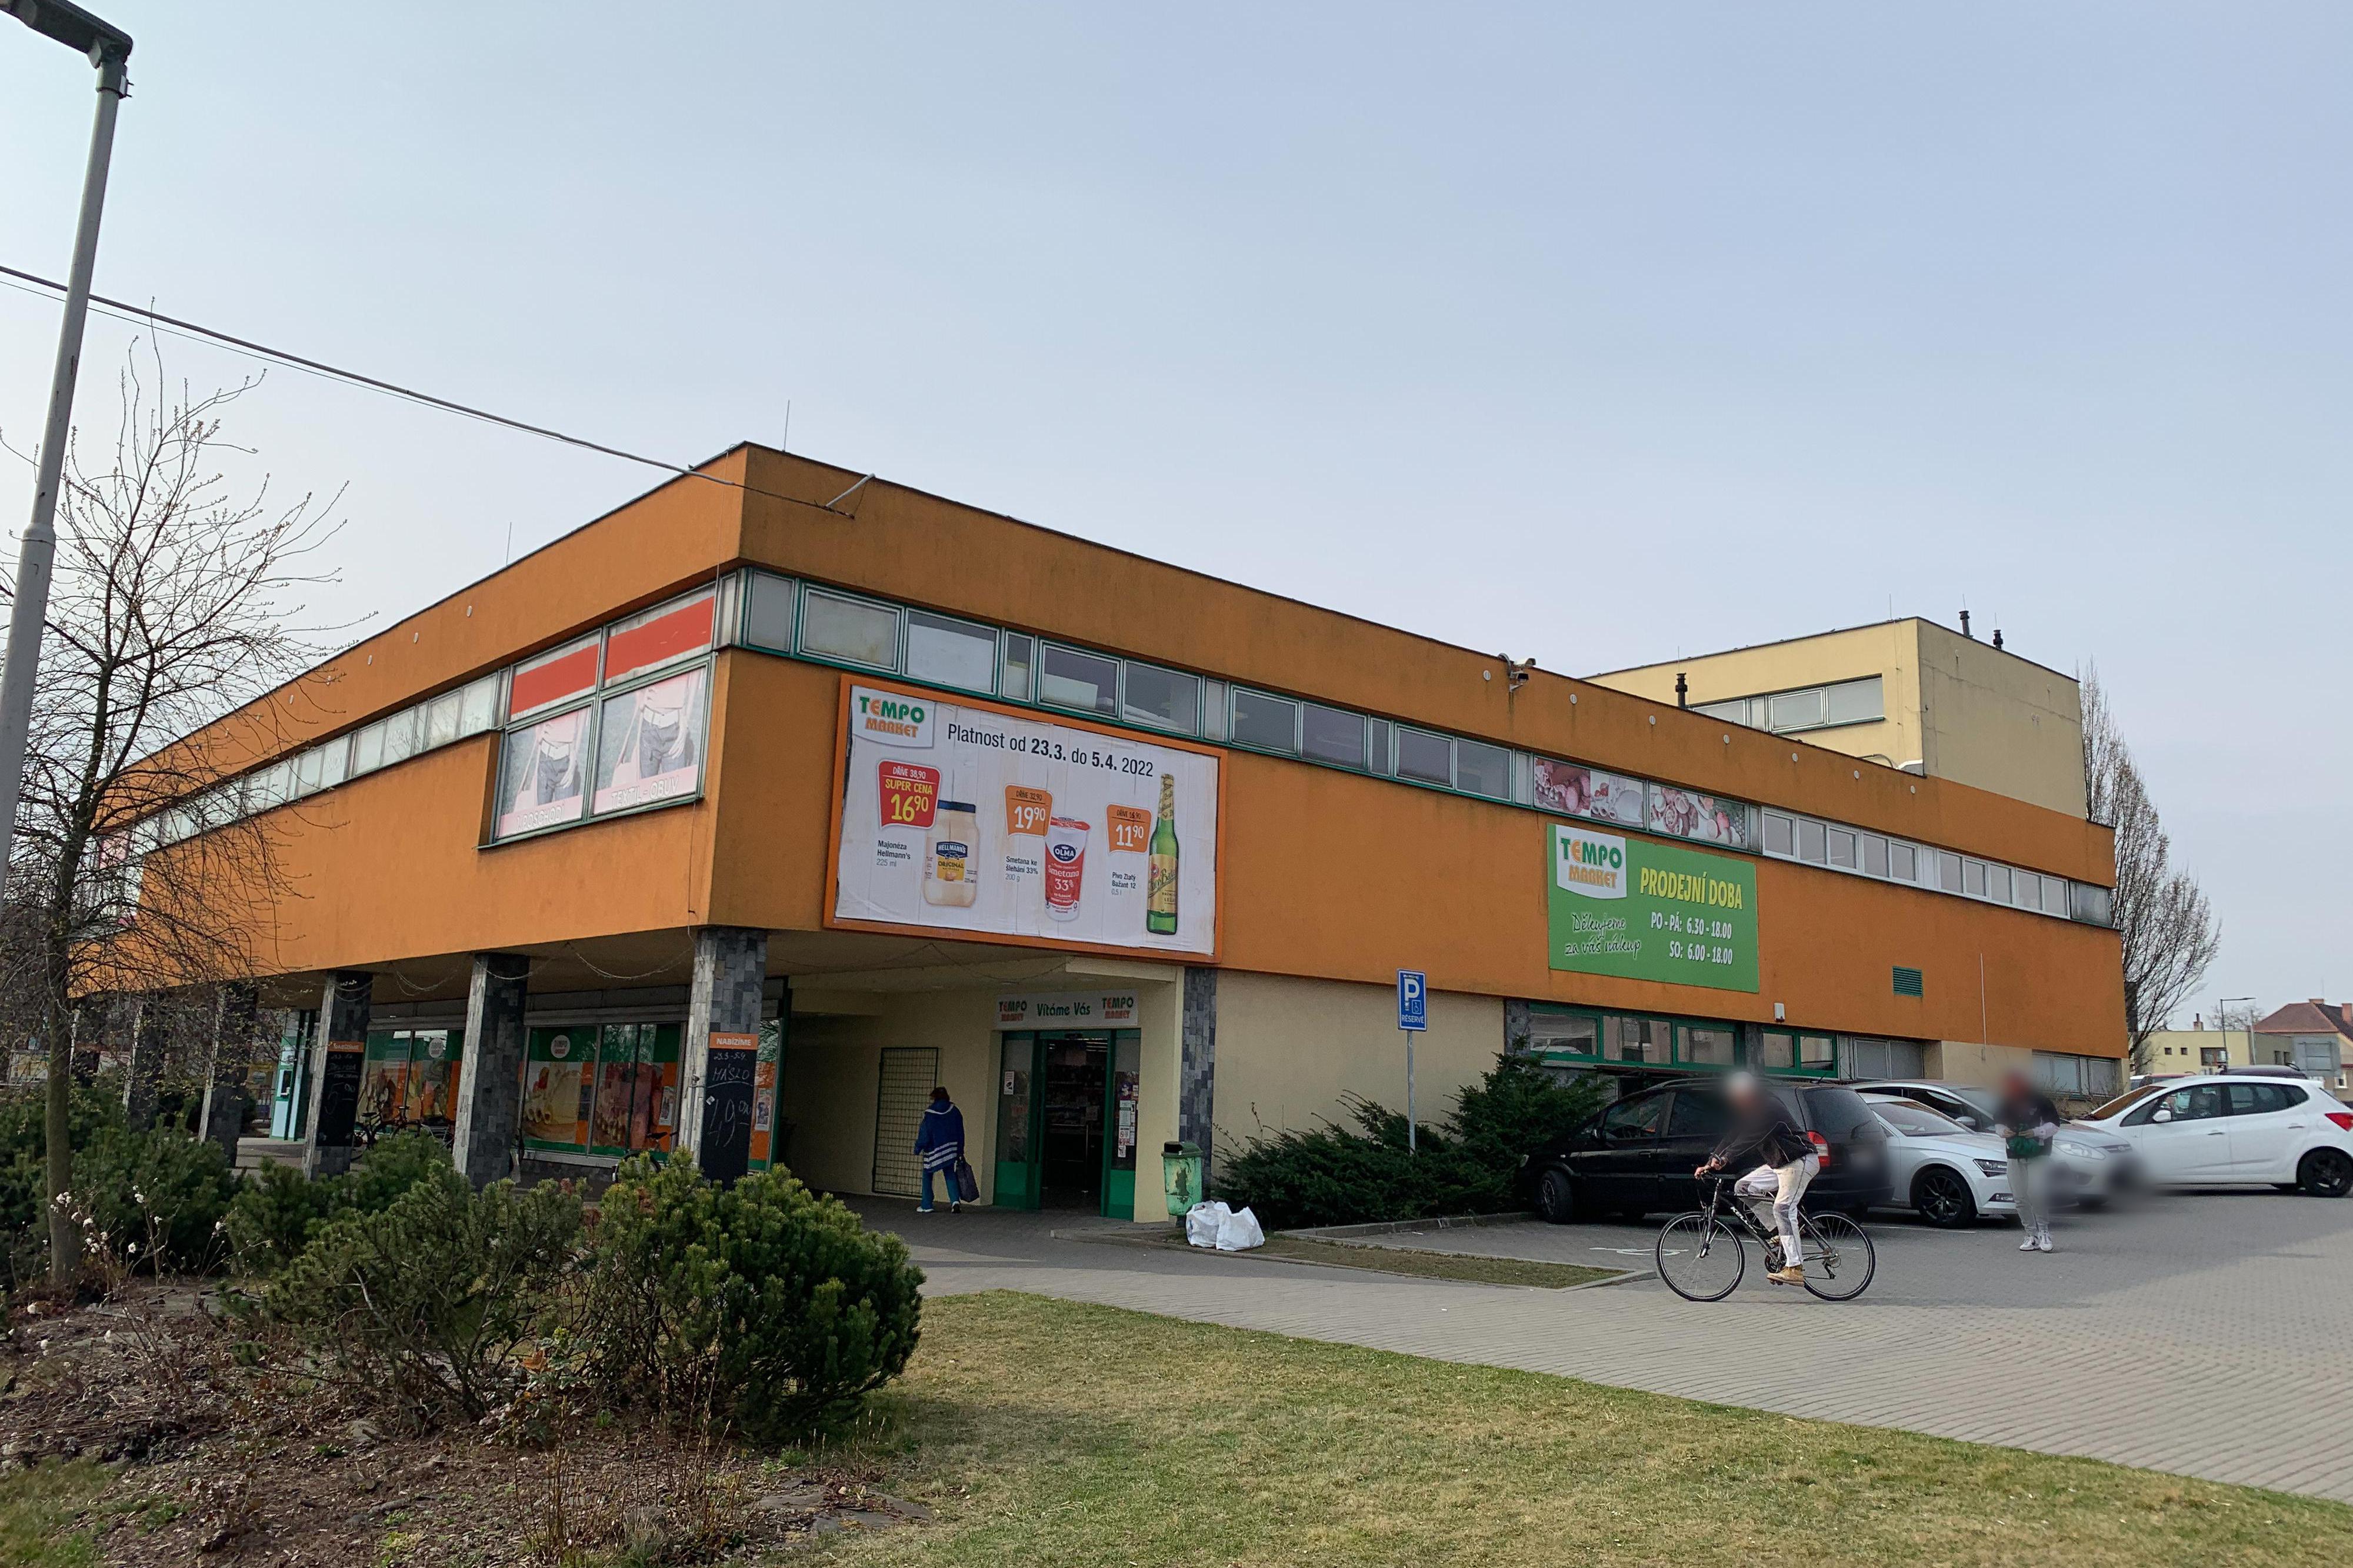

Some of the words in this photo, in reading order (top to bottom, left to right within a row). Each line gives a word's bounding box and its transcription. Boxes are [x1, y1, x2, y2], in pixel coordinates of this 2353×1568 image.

[859, 695, 925, 723] TEMPO
[865, 717, 919, 738] MARKET
[948, 723, 1004, 748] Platnost
[1010, 736, 1026, 752] od
[1031, 738, 1066, 760] 23.3.
[1072, 748, 1086, 765] do
[1092, 751, 1117, 770] 5.4.
[1122, 757, 1154, 777] 2022
[885, 778, 911, 792] SUPER
[914, 783, 933, 795] CENA
[878, 840, 907, 850] Majonéza
[1054, 848, 1075, 857] OLMA
[877, 849, 911, 860] Hellmann's
[1006, 856, 1029, 865] Smetana
[1561, 838, 1622, 869] TEMPO
[876, 858, 888, 866] 225
[1005, 863, 1025, 873] šlehání
[1026, 866, 1038, 875] 33%
[1048, 865, 1079, 878] Smetana
[1124, 873, 1136, 882] Zlatý
[1568, 865, 1617, 889] MARKET
[1112, 880, 1128, 888] Bažant
[1640, 867, 1707, 904] PRODEJNÍ
[1708, 879, 1743, 909] DOBA
[1572, 913, 1626, 938] Děkujeme
[1651, 912, 1663, 929] PO
[1669, 912, 1682, 932] PÁ:
[1687, 917, 1704, 935] 6.30
[1711, 921, 1732, 939] 18.00
[1565, 944, 1579, 955] za
[1582, 935, 1601, 953] váš
[1605, 935, 1641, 959] nákup
[1669, 940, 1683, 958] SO:
[1688, 943, 1705, 961] 6.00
[1712, 946, 1732, 965] 18.00
[1404, 978, 1420, 1010] P
[999, 1000, 1027, 1012] TEMPO
[1036, 1003, 1070, 1016] Vítáme
[1074, 1002, 1091, 1016] Vás
[1102, 997, 1134, 1009] TEMPO
[716, 1036, 752, 1046] NABÍZÍME
[712, 1063, 750, 1081] MÁSLO
